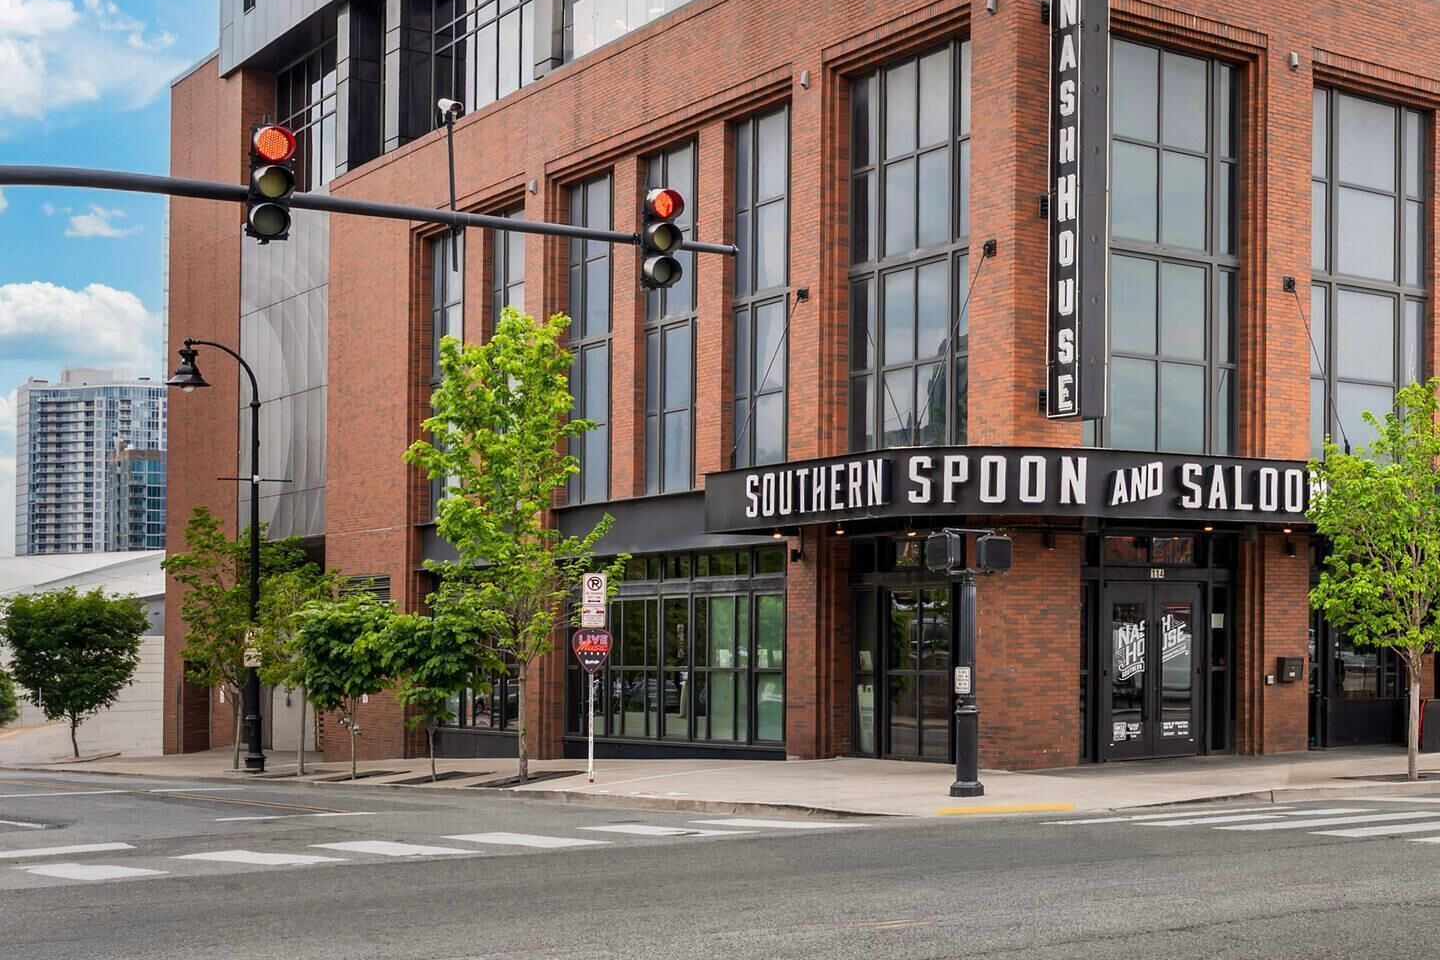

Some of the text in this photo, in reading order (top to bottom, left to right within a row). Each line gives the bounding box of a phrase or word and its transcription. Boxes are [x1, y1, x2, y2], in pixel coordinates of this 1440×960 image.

[745, 459, 883, 518] SOUTHERN
[908, 455, 1088, 504] SPOON
[1111, 461, 1163, 506] AND
[578, 634, 608, 644] LIVE
